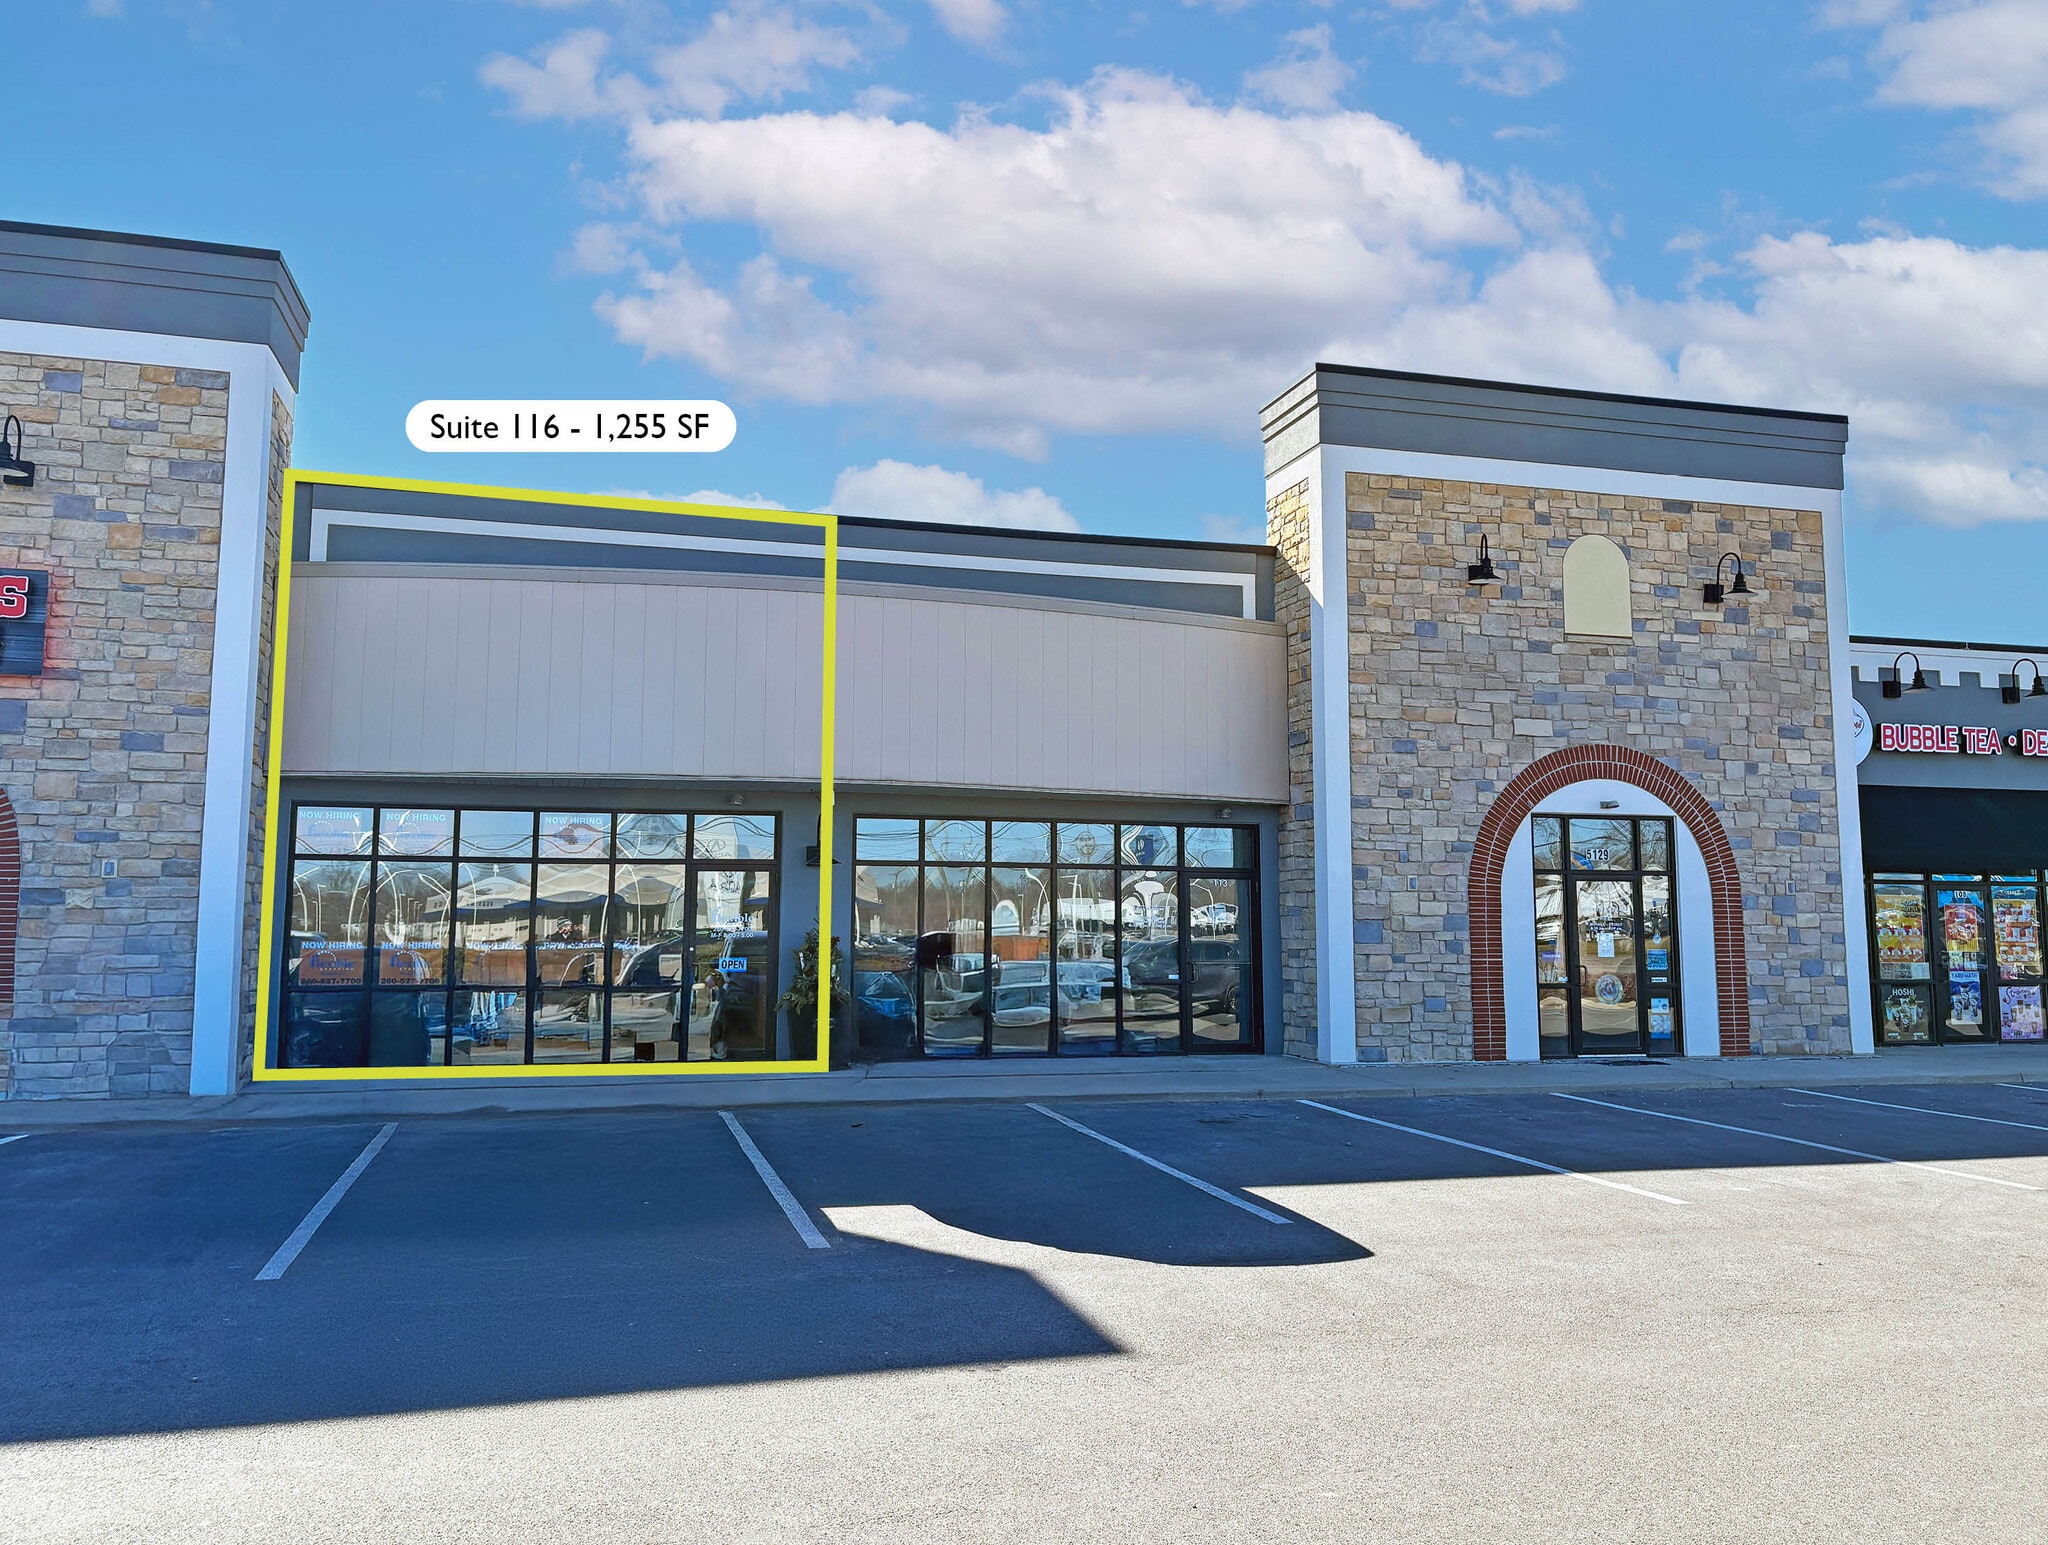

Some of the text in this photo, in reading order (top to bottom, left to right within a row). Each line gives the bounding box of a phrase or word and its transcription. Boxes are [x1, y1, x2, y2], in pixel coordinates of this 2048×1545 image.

[1881, 723, 1960, 753] BUBBLE
[1963, 726, 2002, 755] TEA
[300, 811, 361, 819] NOW HIRING
[412, 813, 446, 822] HIRING
[545, 816, 602, 825] NOW HIRING
[1586, 849, 1610, 860] 5129
[301, 941, 363, 949] NOW HIRING
[382, 941, 441, 949] NOW HIRING
[721, 959, 745, 969] OPEN
